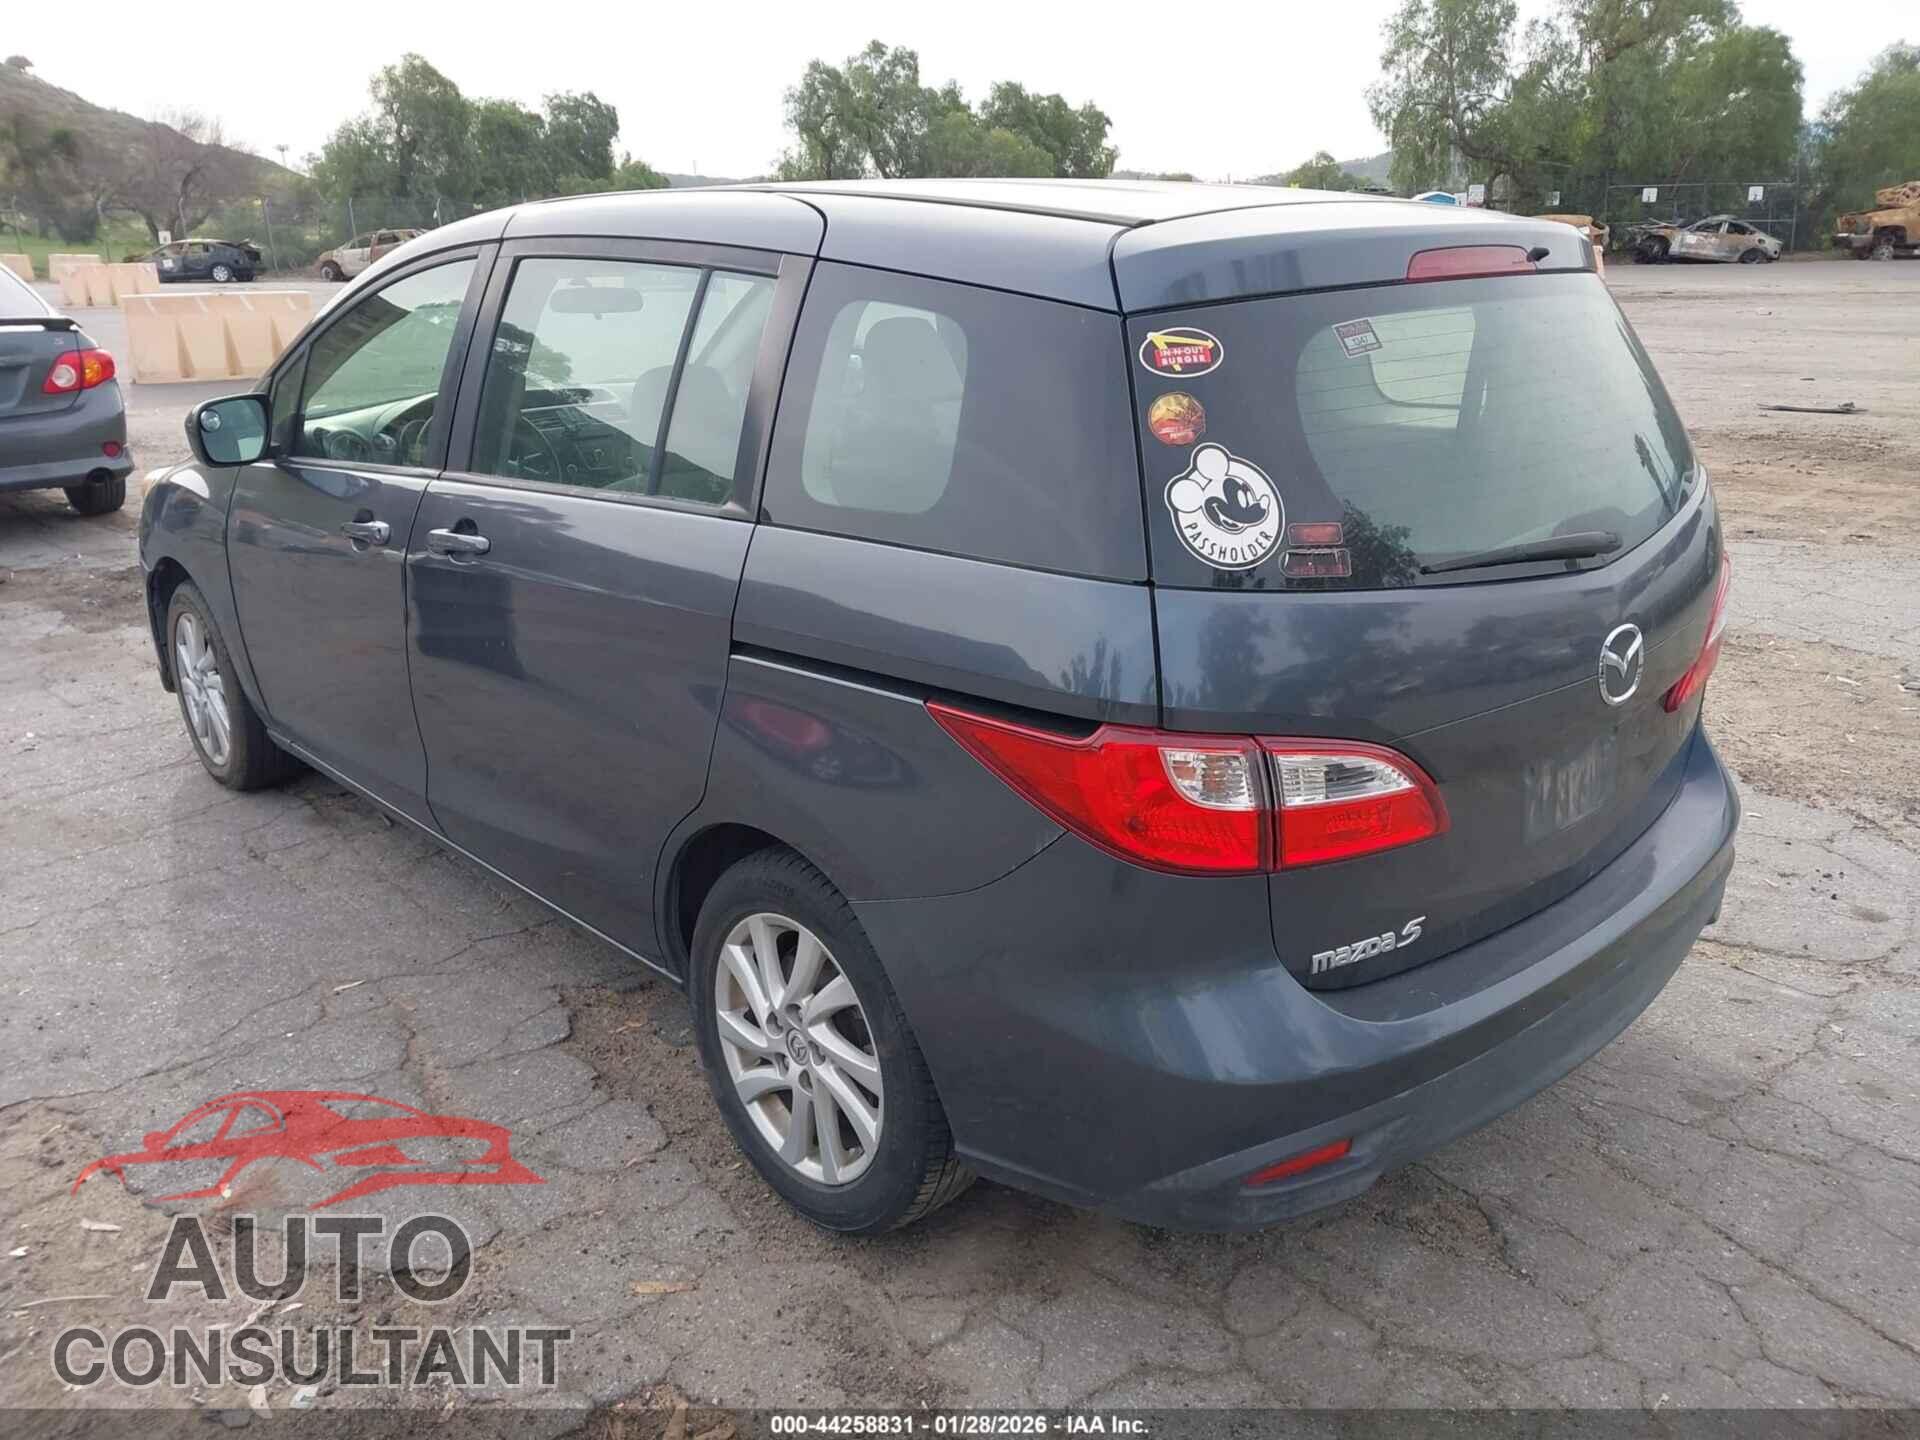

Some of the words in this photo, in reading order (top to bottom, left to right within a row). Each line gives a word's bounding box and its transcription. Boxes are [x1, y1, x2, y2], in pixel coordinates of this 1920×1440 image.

[1159, 345, 1204, 357] IN-N-OUT
[1160, 354, 1206, 366] BURGER
[1184, 522, 1273, 562] PASSHOLDER
